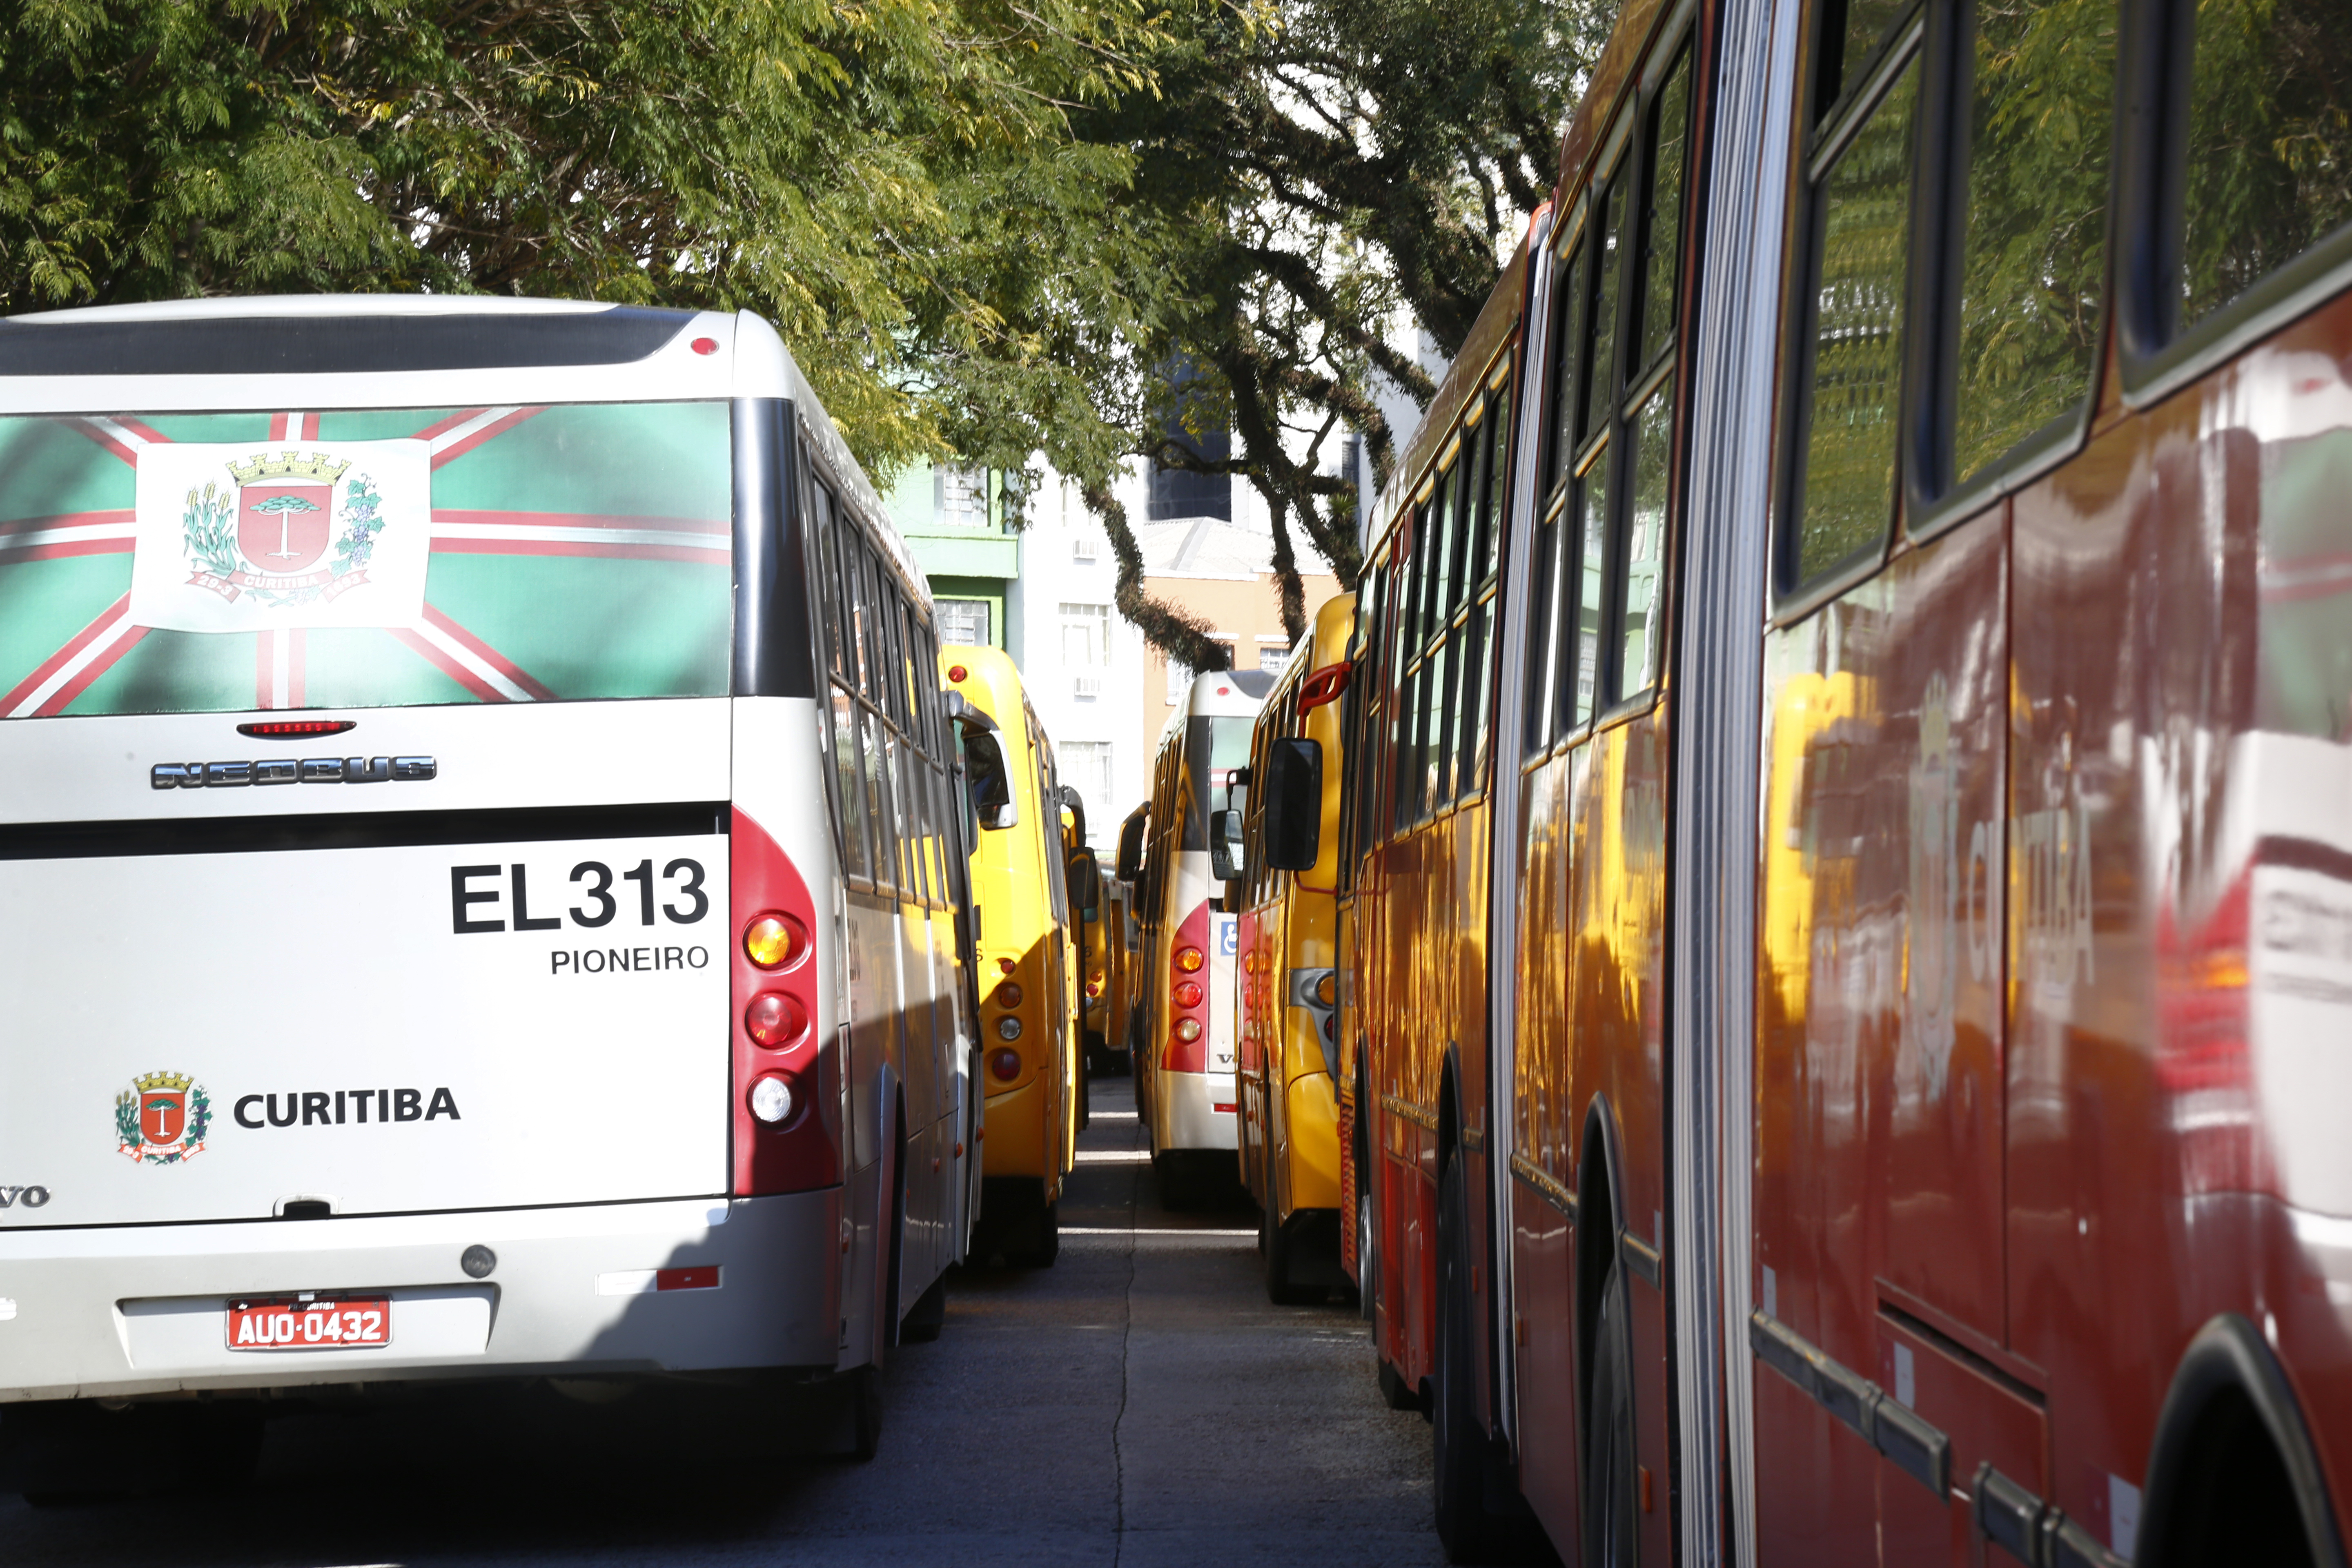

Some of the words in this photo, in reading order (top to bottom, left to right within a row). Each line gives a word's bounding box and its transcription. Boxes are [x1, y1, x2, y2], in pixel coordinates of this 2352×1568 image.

[197, 575, 234, 596] 29-3
[244, 575, 319, 589] CURITIBA
[326, 574, 361, 596] 1693
[150, 755, 437, 789] NEOBUS
[451, 858, 709, 934] EL313
[551, 946, 709, 975] PIONEIRO
[233, 1087, 461, 1129] CURITIBA
[141, 1145, 182, 1155] CURITIBA
